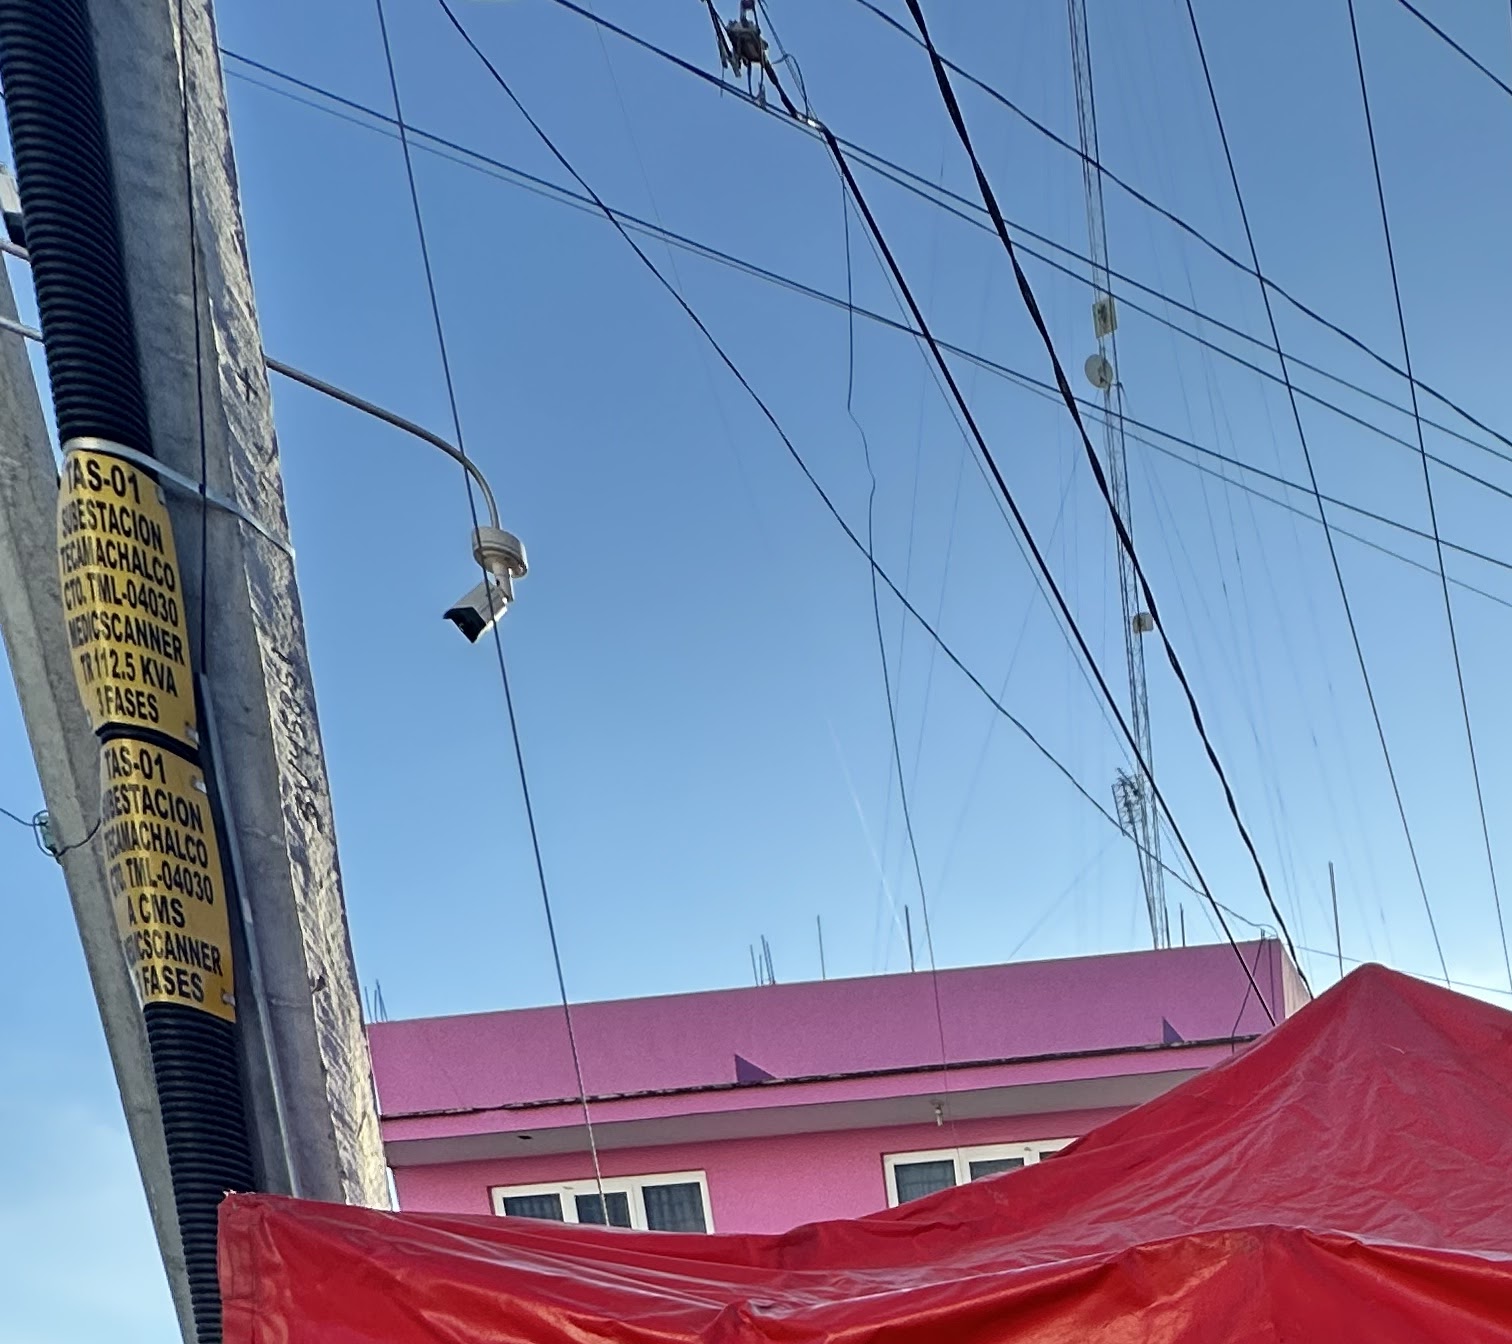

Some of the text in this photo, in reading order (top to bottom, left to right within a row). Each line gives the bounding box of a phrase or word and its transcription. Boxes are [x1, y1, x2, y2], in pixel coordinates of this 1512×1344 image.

[66, 458, 140, 504] TAS-01
[62, 499, 164, 555] SUBESTACION
[61, 536, 174, 591] TECAMACHALCO
[87, 572, 178, 627] TML-04030
[69, 610, 185, 666] MEDICSCANNER
[94, 647, 136, 681] 112.5
[140, 655, 178, 697] KVA
[104, 685, 159, 723] FASES
[104, 746, 166, 784] TAS-01
[126, 857, 213, 905] TML-04030
[139, 893, 185, 928] CMS
[142, 964, 203, 1003] FASES
